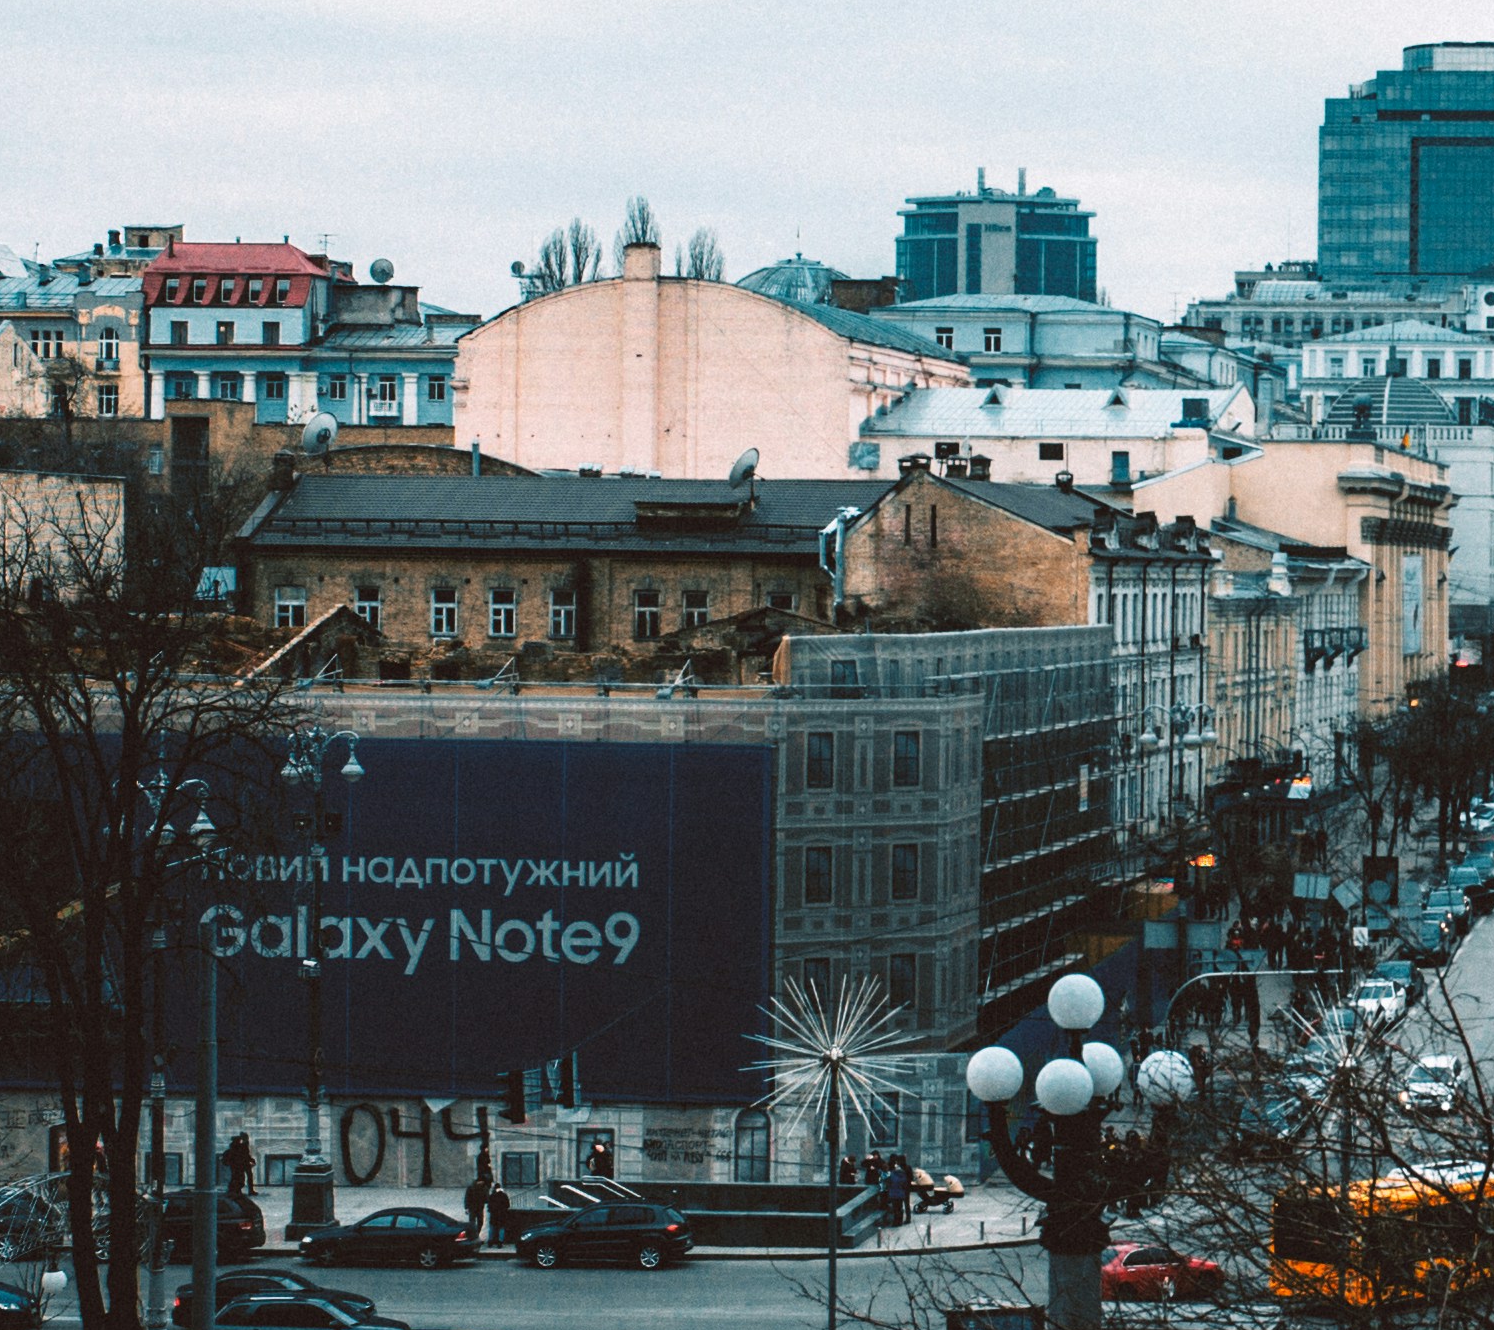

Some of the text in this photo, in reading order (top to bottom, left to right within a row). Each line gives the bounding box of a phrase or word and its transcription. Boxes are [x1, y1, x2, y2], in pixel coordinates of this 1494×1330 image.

[343, 852, 639, 896] надпотужний
[199, 903, 641, 975] Galaxy Note9
